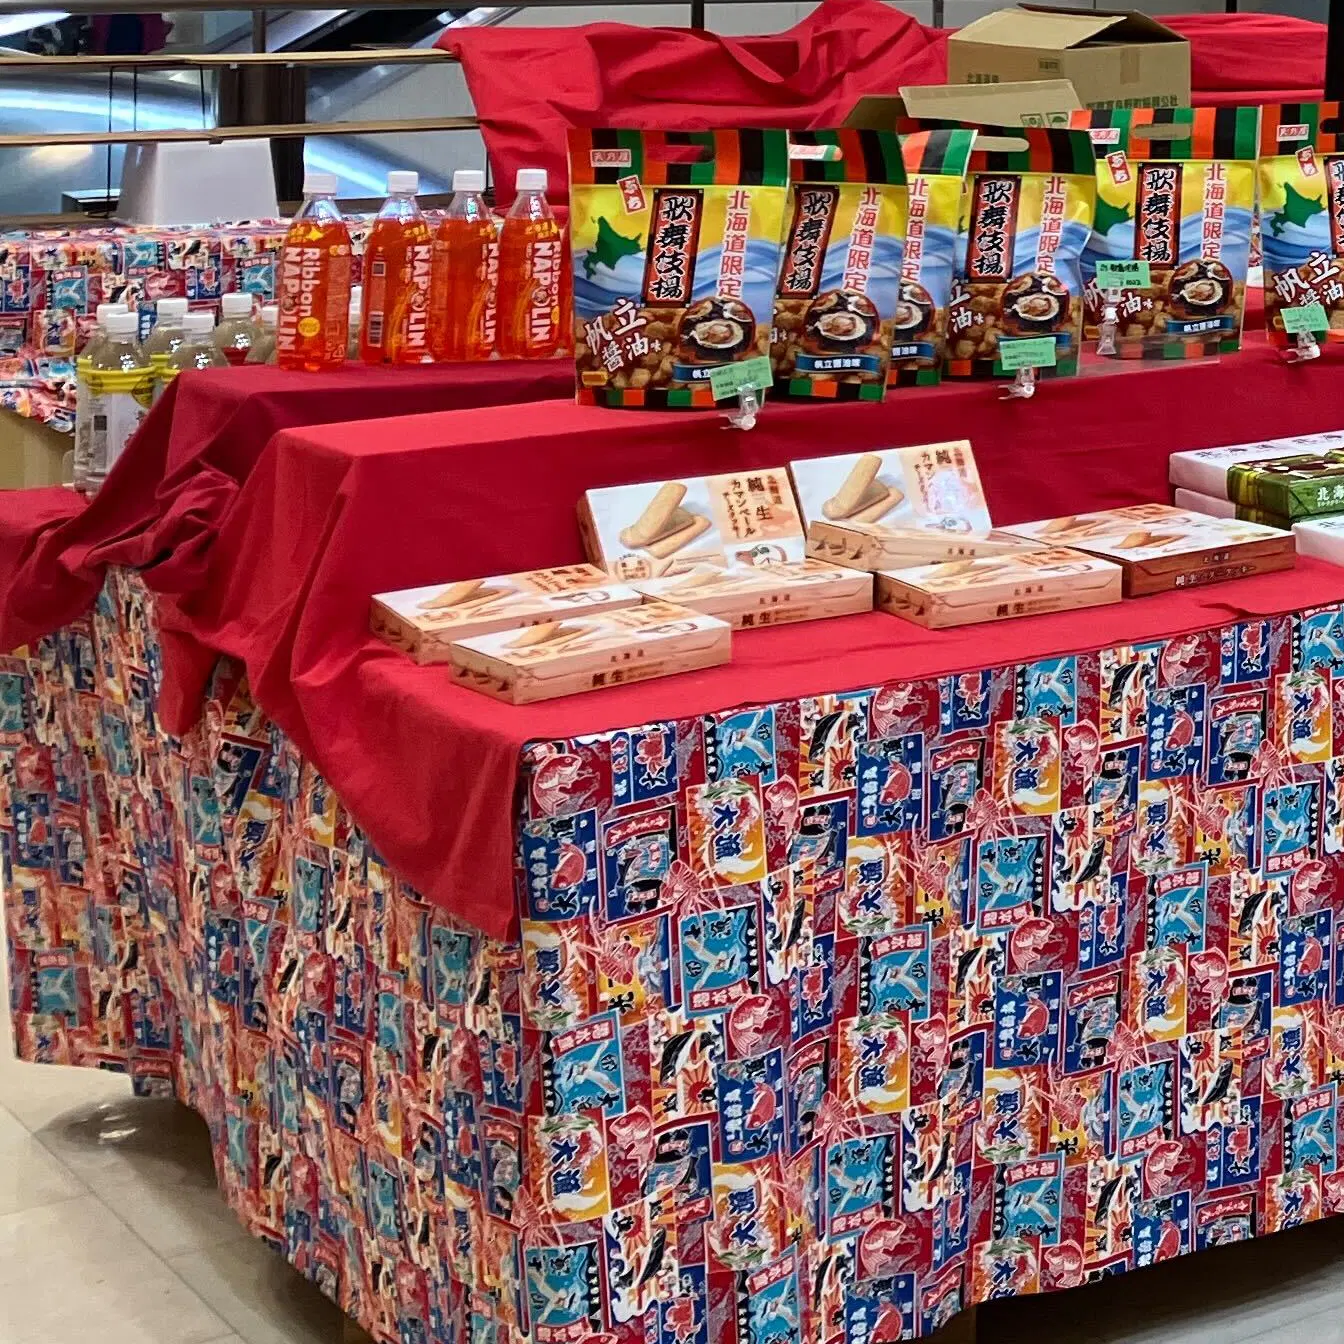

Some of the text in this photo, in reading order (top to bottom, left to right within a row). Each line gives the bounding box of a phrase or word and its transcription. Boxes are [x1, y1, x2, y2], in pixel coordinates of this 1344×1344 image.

[718, 189, 751, 299] 北海道限定
[842, 186, 881, 293] 北海道限定
[1037, 176, 1066, 274] 北海道限定
[1201, 163, 1227, 261] 北海道限定
[299, 247, 321, 317] Ribbon
